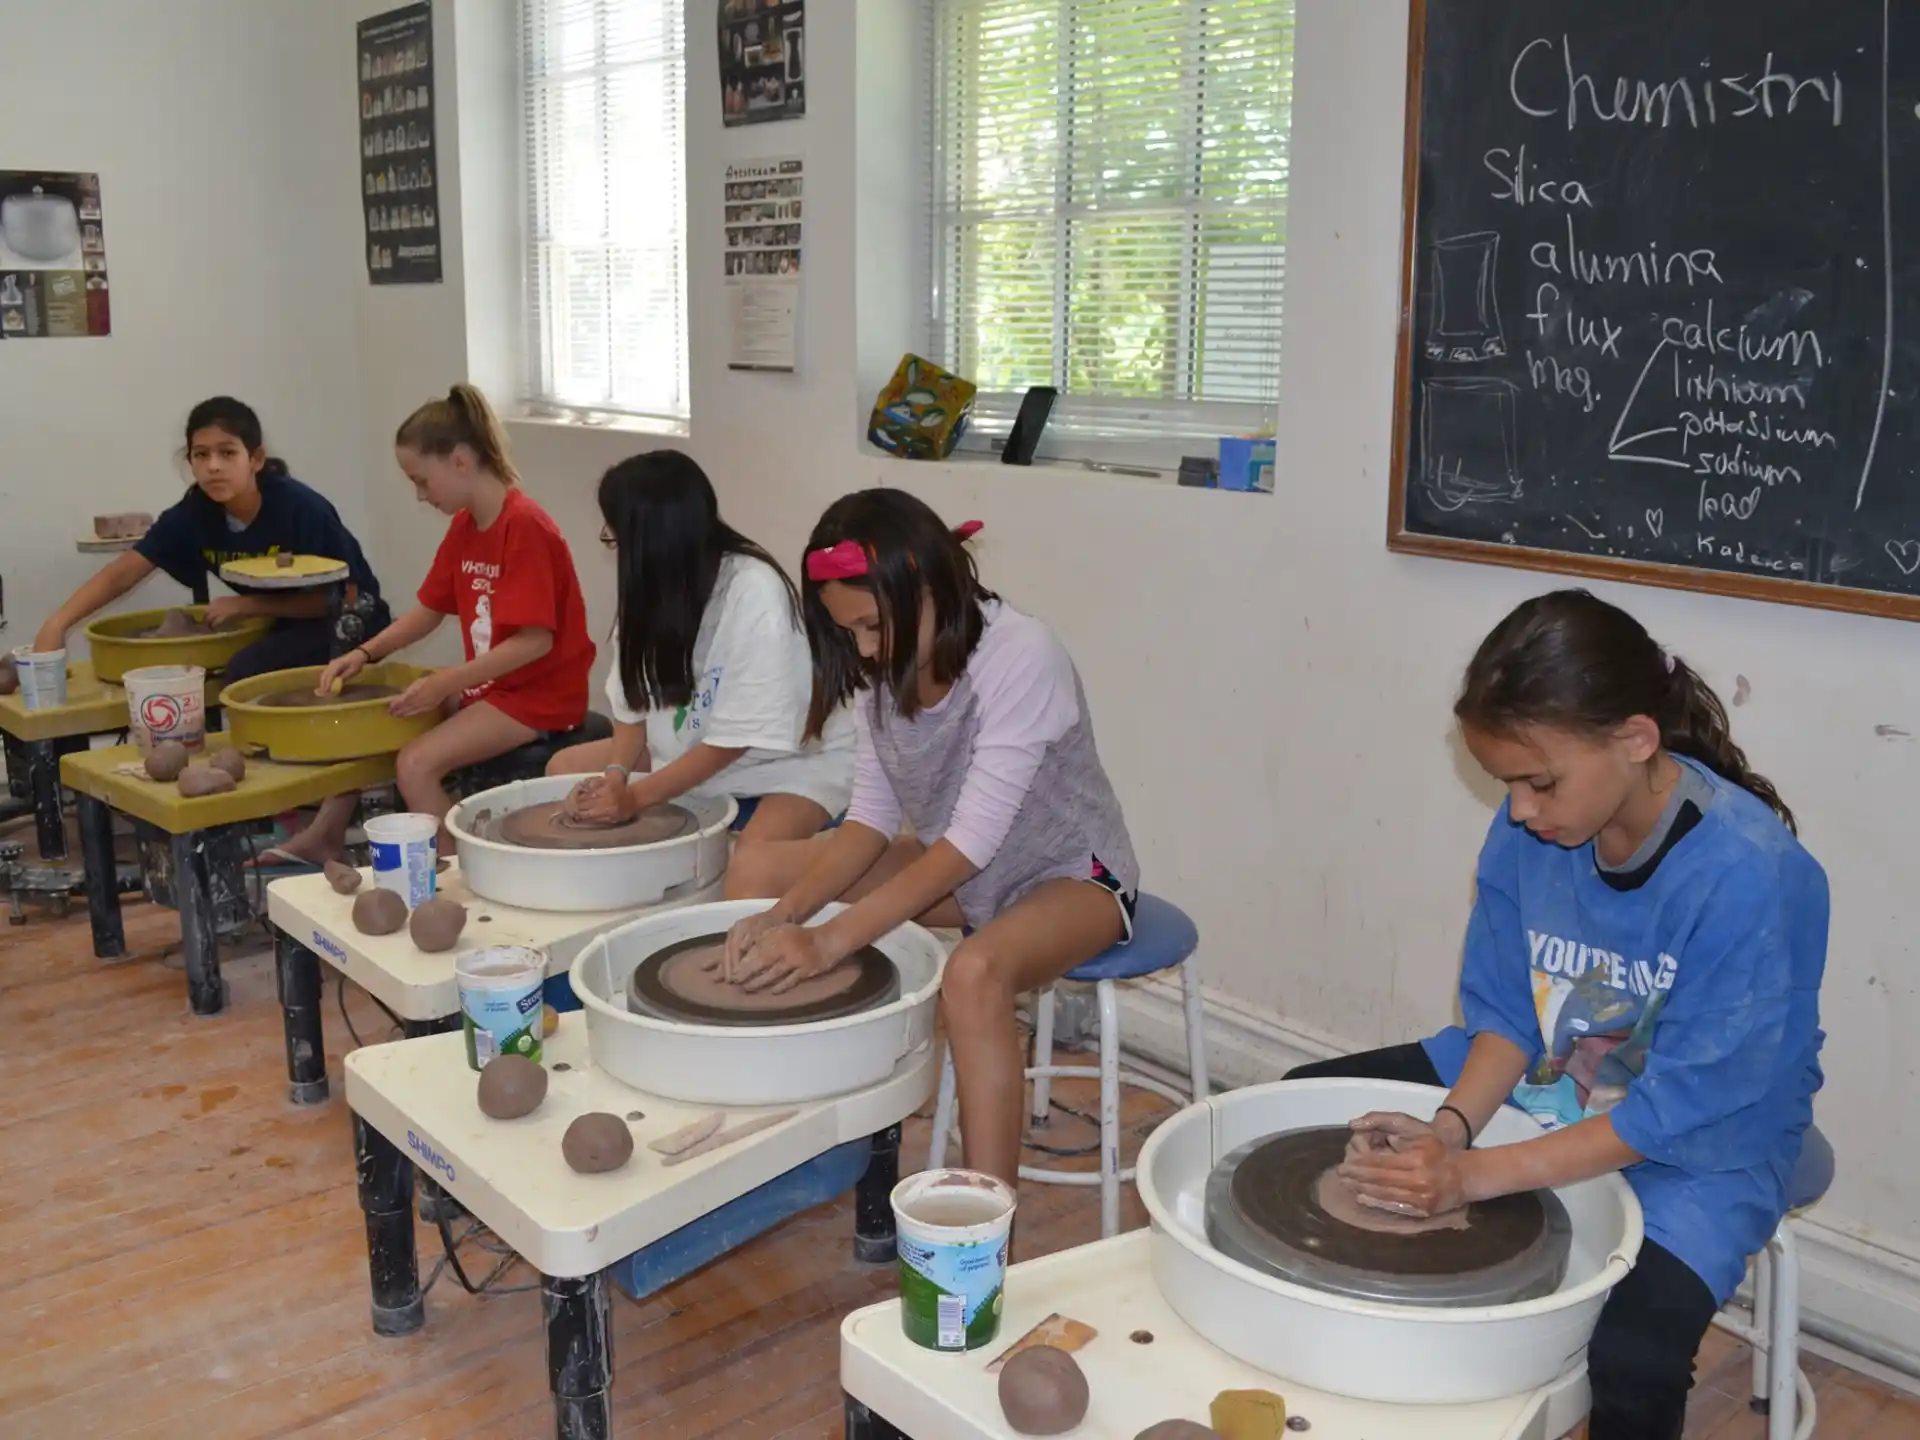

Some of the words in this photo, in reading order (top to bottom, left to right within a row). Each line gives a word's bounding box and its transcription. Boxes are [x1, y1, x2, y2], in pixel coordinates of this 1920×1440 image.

[1530, 213, 1723, 286] alumina
[1525, 283, 1623, 358] flux
[1698, 480, 1761, 521] lead
[312, 930, 348, 965] SHIMPO
[407, 1130, 456, 1183] SHIMPO
